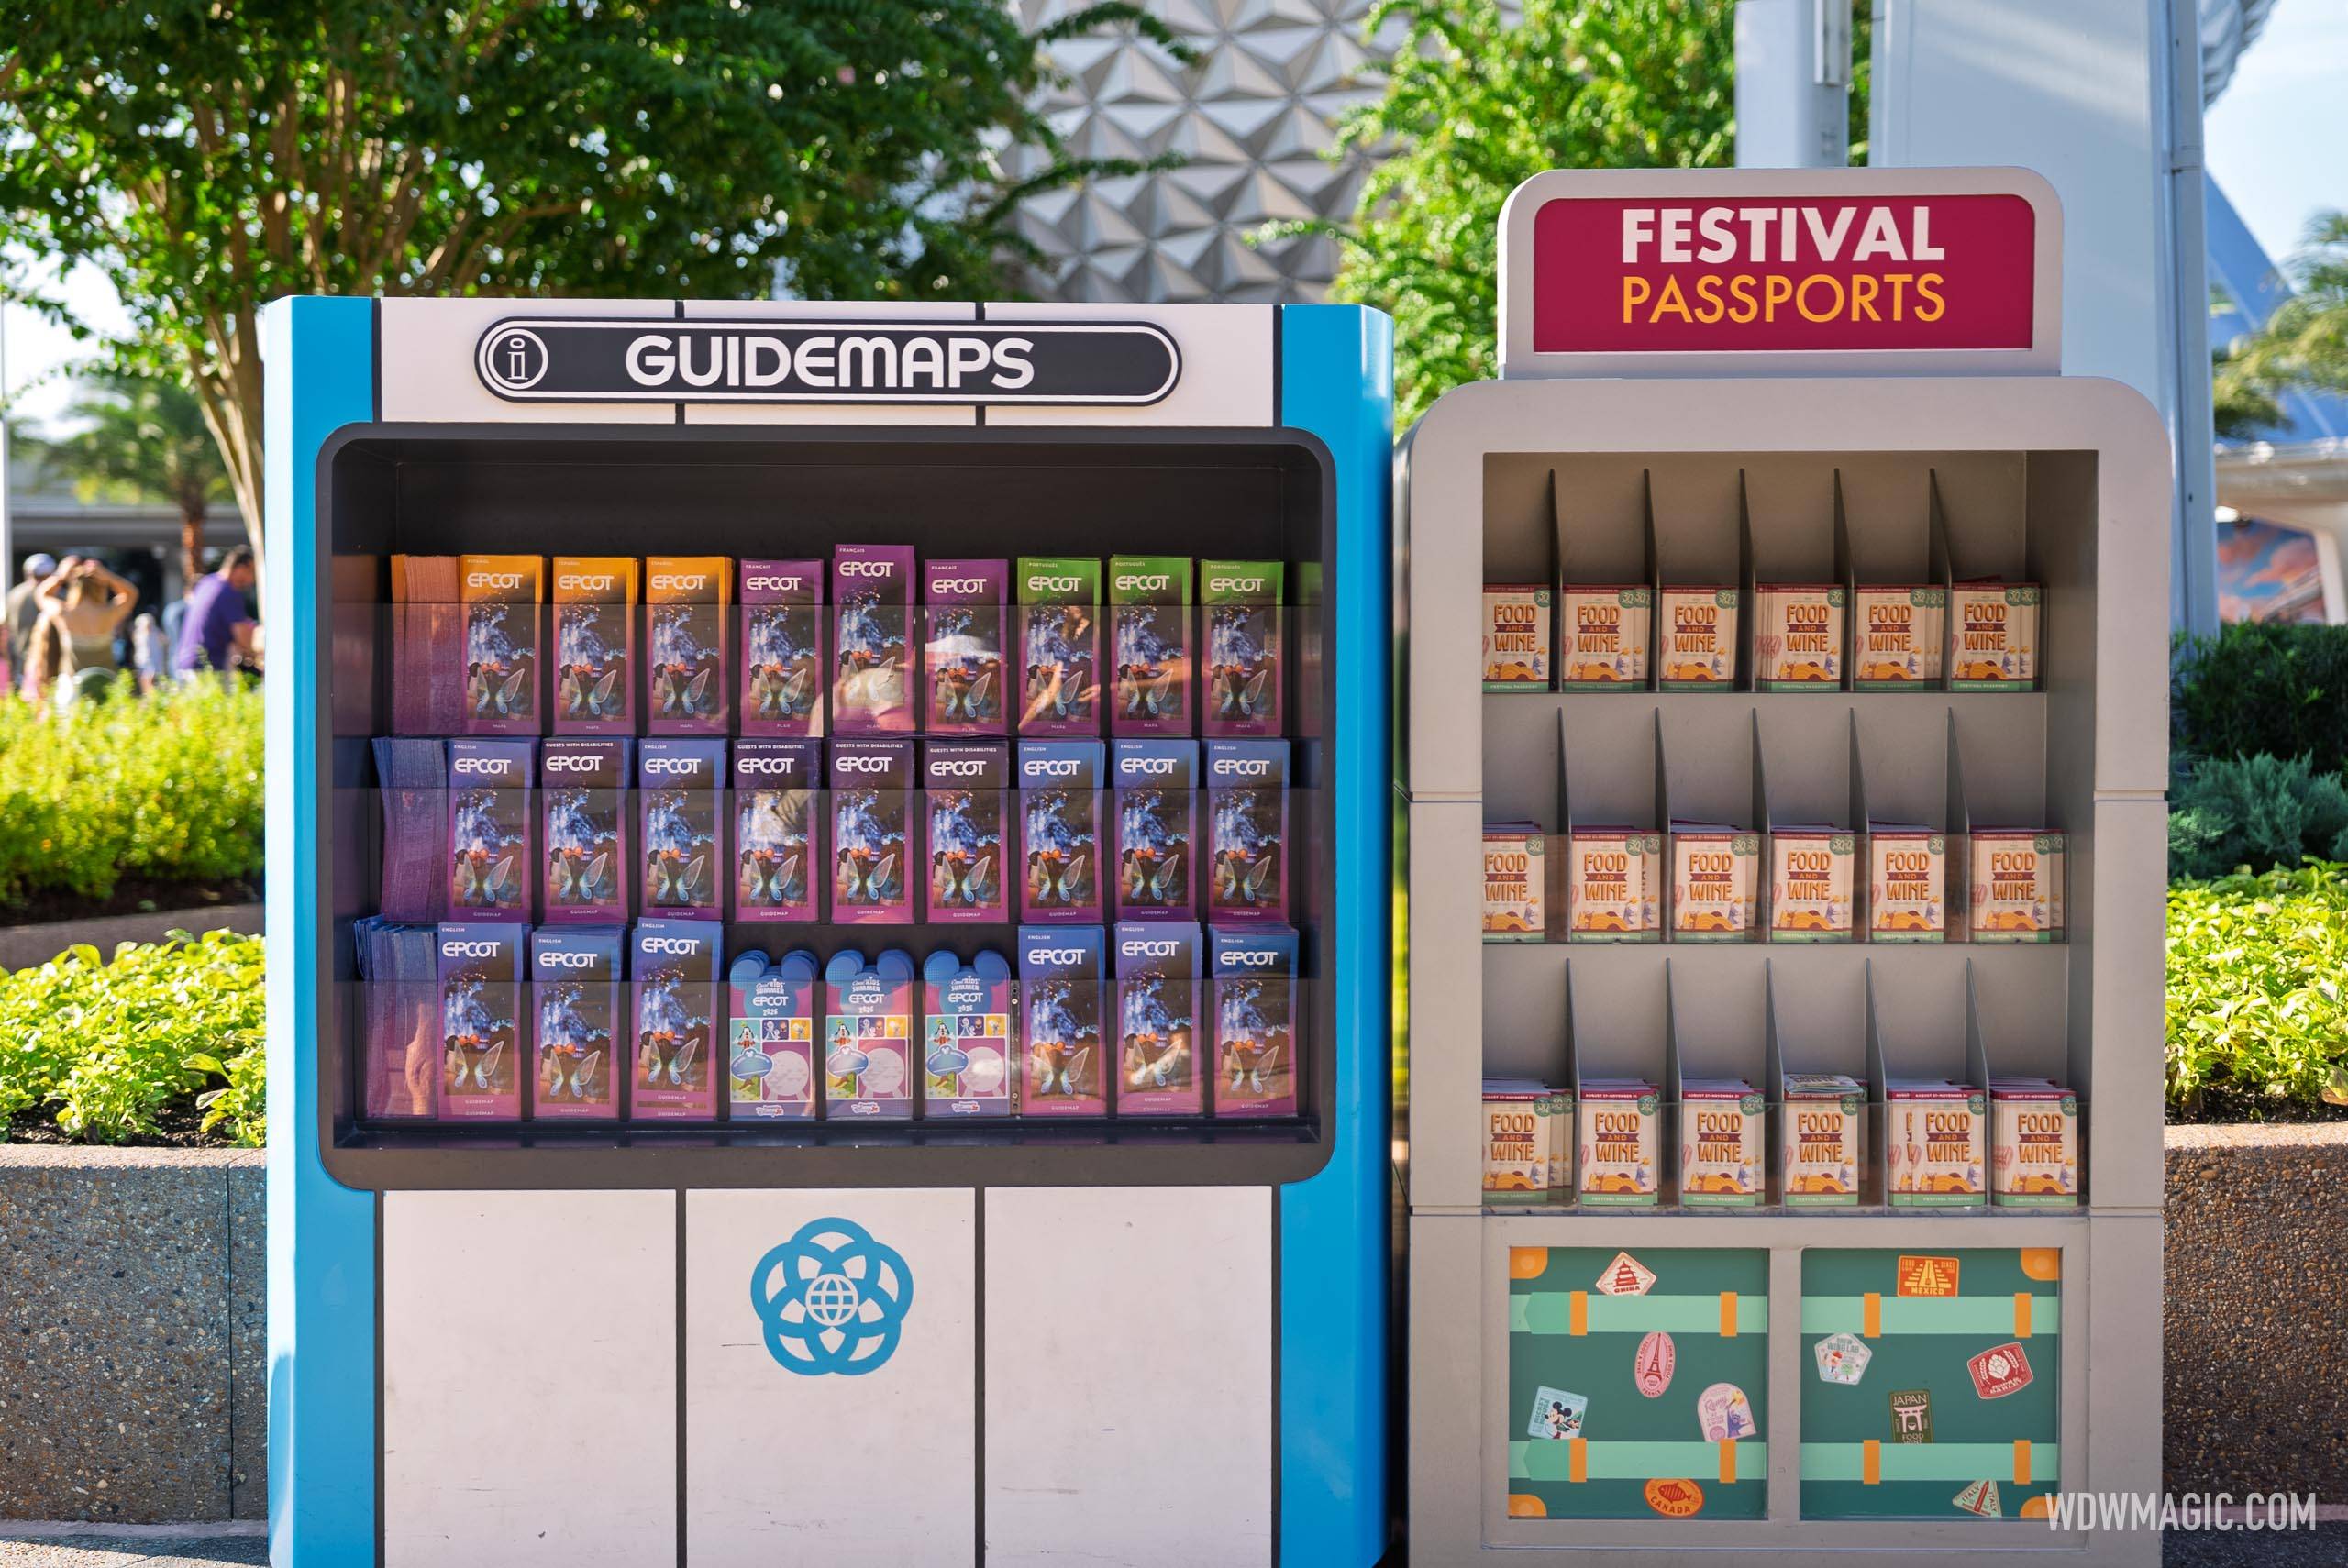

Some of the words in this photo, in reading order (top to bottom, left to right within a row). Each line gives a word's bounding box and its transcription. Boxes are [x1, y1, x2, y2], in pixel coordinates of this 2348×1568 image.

[1622, 206, 1944, 264] FESTIVAL
[1623, 273, 1945, 325] PASSPORTS
[625, 335, 1034, 390] GUIDEMAPS
[839, 561, 894, 577] EPCOT
[467, 572, 523, 589] EPCOT
[558, 574, 615, 591] EPCOT
[651, 574, 706, 590] EPCOT
[746, 577, 802, 591] EPCOT
[931, 578, 987, 594] EPCOT
[1027, 576, 1082, 591] EPCOT
[1115, 575, 1169, 591] EPCOT
[1210, 578, 1265, 592] EPCOT
[1494, 604, 1537, 624] FOOD
[1578, 605, 1621, 624] FOOD
[1675, 605, 1717, 624] FOOD
[1787, 604, 1828, 623] FOOD
[1869, 604, 1912, 624] FOOD
[1964, 603, 2007, 623] FOOD
[1494, 634, 1536, 652] WINE
[1578, 635, 1620, 653] WINE
[1675, 635, 1716, 653] WINE
[1787, 634, 1828, 652] WINE
[1869, 634, 1911, 652] WINE
[1965, 633, 2006, 651] WINE
[454, 758, 512, 774] EPCOT
[546, 756, 604, 772] EPCOT
[644, 758, 702, 775] EPCOT
[737, 757, 794, 774] EPCOT
[836, 756, 892, 773] EPCOT
[929, 760, 987, 777] EPCOT
[1024, 760, 1080, 776] EPCOT
[1120, 758, 1177, 774] EPCOT
[1213, 759, 1270, 776] EPCOT
[1485, 853, 1527, 872] FOOD
[1584, 853, 1628, 872] FOOD
[1689, 853, 1733, 872] FOOD
[1788, 851, 1832, 871] FOOD
[1886, 851, 1931, 871] FOOD
[1991, 852, 2036, 871] FOOD
[1485, 883, 1527, 901] WINE
[1585, 883, 1627, 901] WINE
[1689, 883, 1732, 901] WINE
[1788, 881, 1830, 900] WINE
[1887, 881, 1929, 900] WINE
[1992, 881, 2035, 900] WINE
[442, 941, 500, 957] EPCOT
[641, 937, 700, 955] EPCOT
[1122, 941, 1180, 956] EPCOT
[538, 952, 597, 967] EPCOT
[1028, 949, 1086, 965] EPCOT
[1220, 951, 1278, 966] EPCOT
[752, 997, 789, 1006] EPCOT
[849, 994, 884, 1003] EPCOT
[948, 992, 983, 1002] EPCOT
[1490, 1113, 1536, 1132] FOOD
[1595, 1112, 1641, 1132] FOOD
[1697, 1112, 1743, 1132] FOOD
[1798, 1112, 1844, 1132] FOOD
[1925, 1112, 1971, 1132] FOOD
[2018, 1112, 2063, 1132] FOOD
[1811, 1133, 1831, 1142] AND
[1938, 1133, 1958, 1142] AND
[1490, 1143, 1534, 1161] WINE
[1596, 1143, 1639, 1163] WINE
[1698, 1143, 1741, 1163] WINE
[1799, 1144, 1843, 1163] WINE
[1926, 1143, 1970, 1163] WINE
[2019, 1144, 2063, 1163] WINE
[1893, 1394, 1927, 1405] JAPAN
[1651, 1496, 1690, 1513] CANADA
